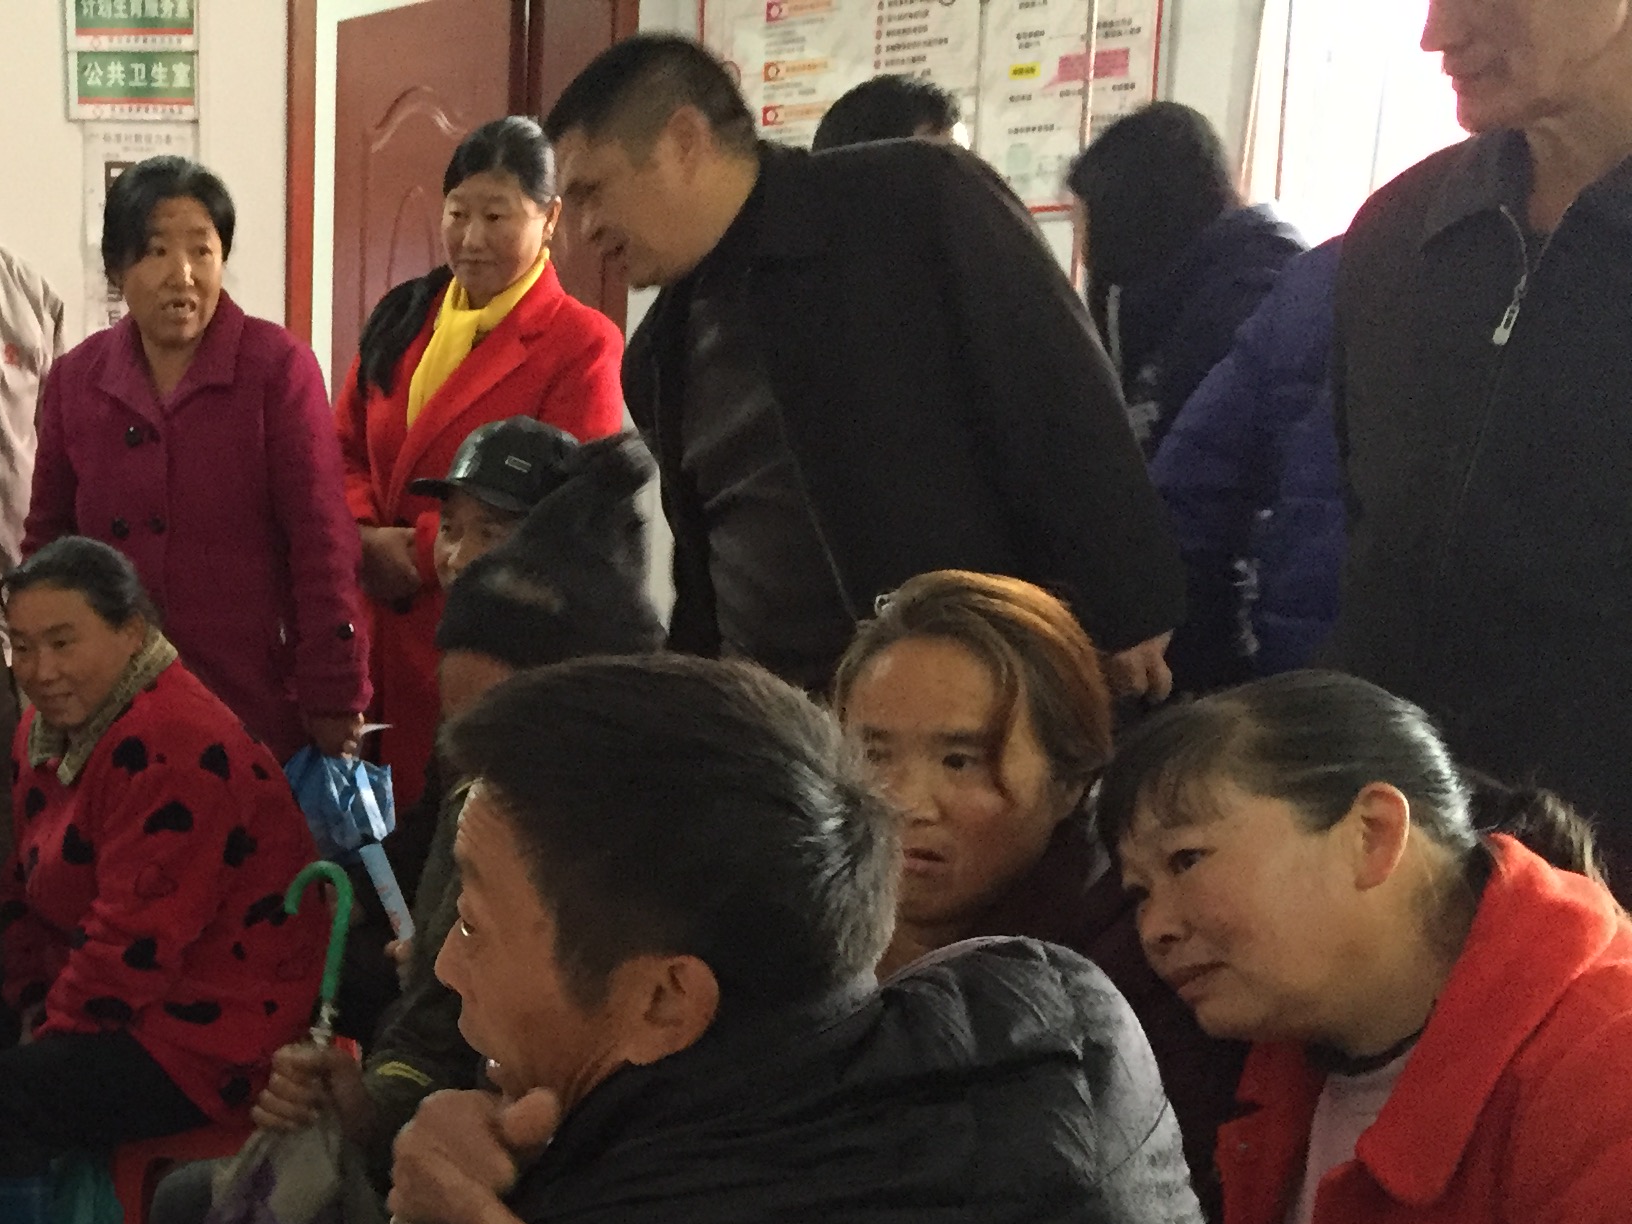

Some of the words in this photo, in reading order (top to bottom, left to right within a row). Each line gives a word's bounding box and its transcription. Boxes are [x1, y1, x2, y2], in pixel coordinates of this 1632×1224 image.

[84, 61, 191, 87] 公共卫生室
